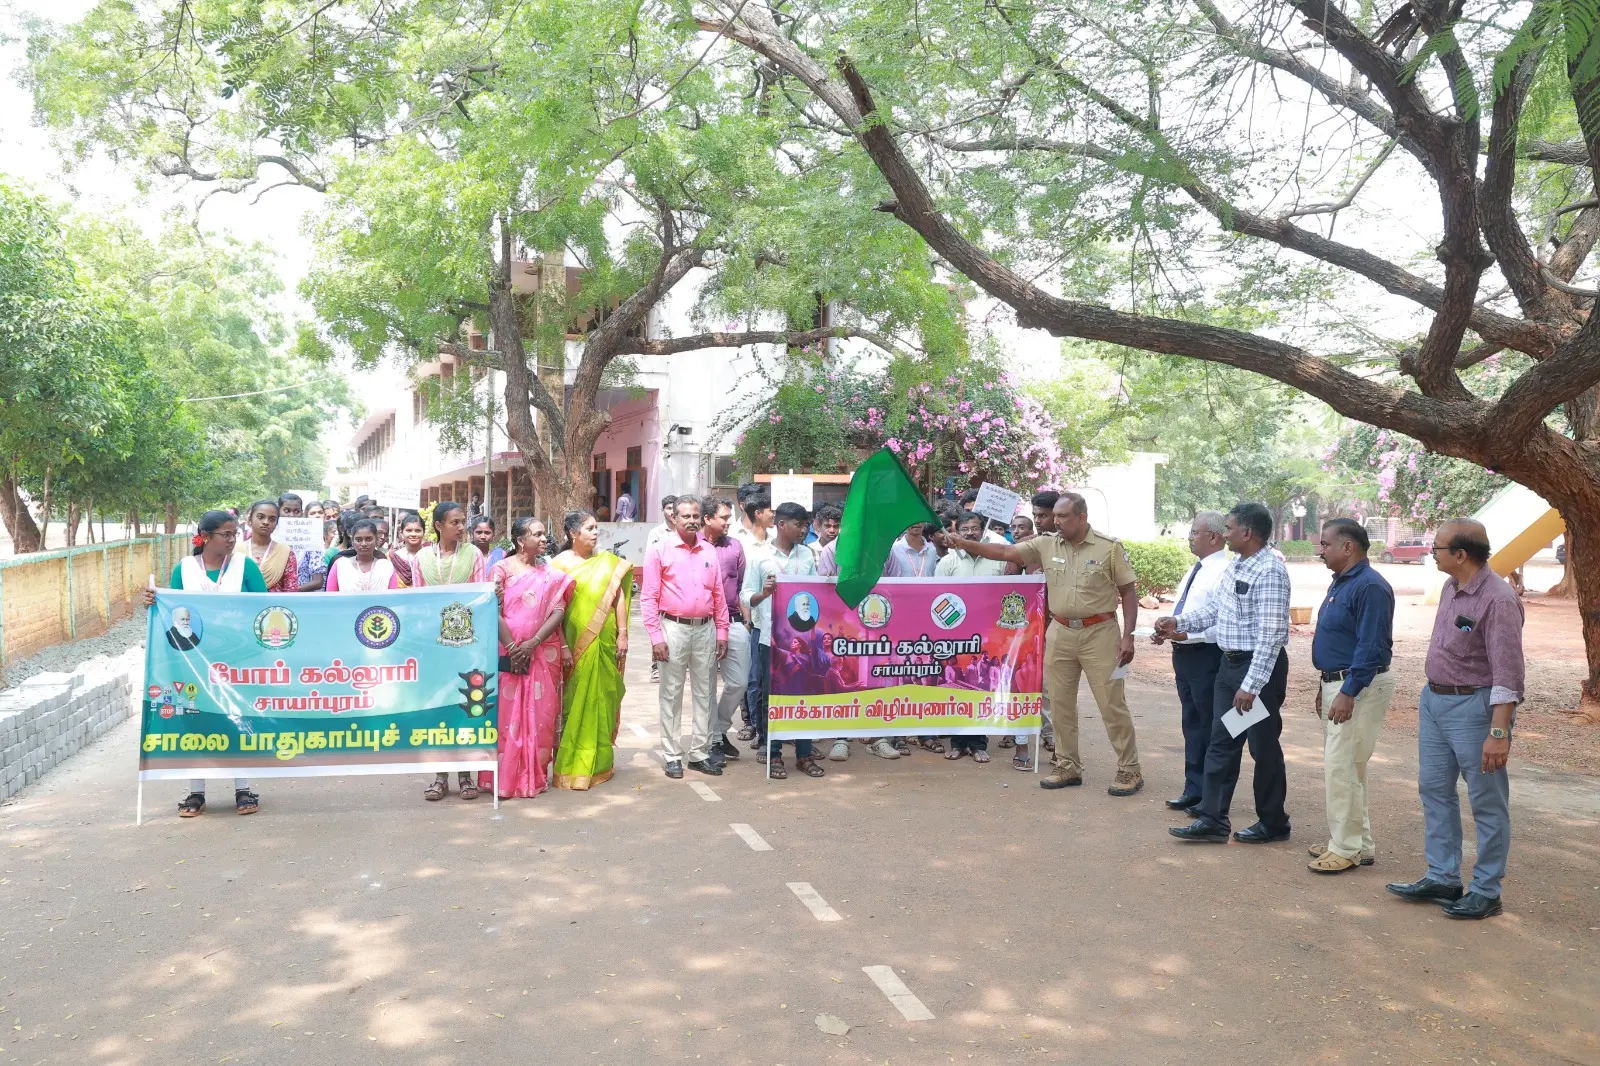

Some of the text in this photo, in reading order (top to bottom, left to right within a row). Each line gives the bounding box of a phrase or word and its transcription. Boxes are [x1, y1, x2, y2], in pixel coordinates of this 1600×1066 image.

[834, 634, 982, 659] போப் கல்லூரி
[210, 658, 418, 689] போப் கல்லூரி
[872, 661, 942, 678] சாயர்புரம்
[254, 690, 376, 713] சாயர்புரம்
[768, 699, 861, 720] வாக்காளர்
[865, 696, 973, 722] விழிப்புணர்வு
[142, 719, 498, 761] சாலை பாதுகாப்புச் சங்கம்
